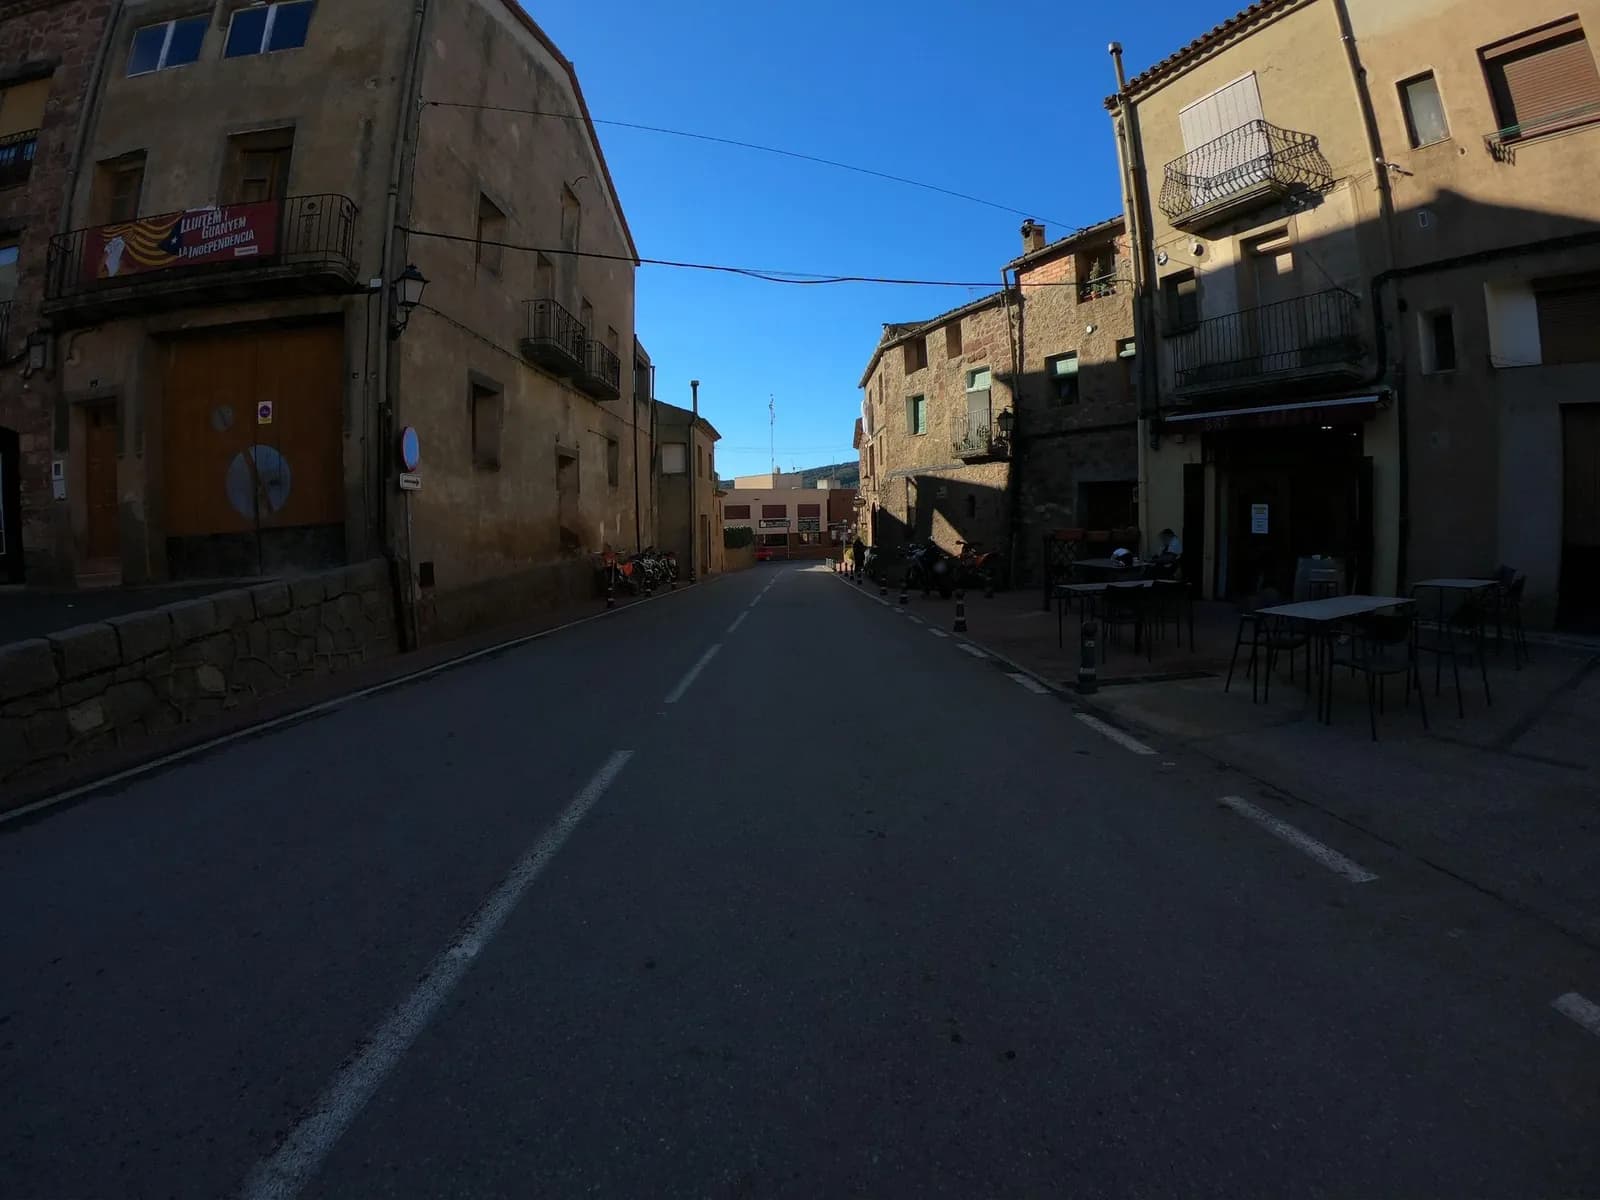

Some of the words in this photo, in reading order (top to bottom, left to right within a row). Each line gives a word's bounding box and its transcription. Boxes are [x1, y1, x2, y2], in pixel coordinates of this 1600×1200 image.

[180, 209, 222, 234] LLUITEM
[202, 215, 247, 239] GUANYEM
[178, 246, 187, 257] LA
